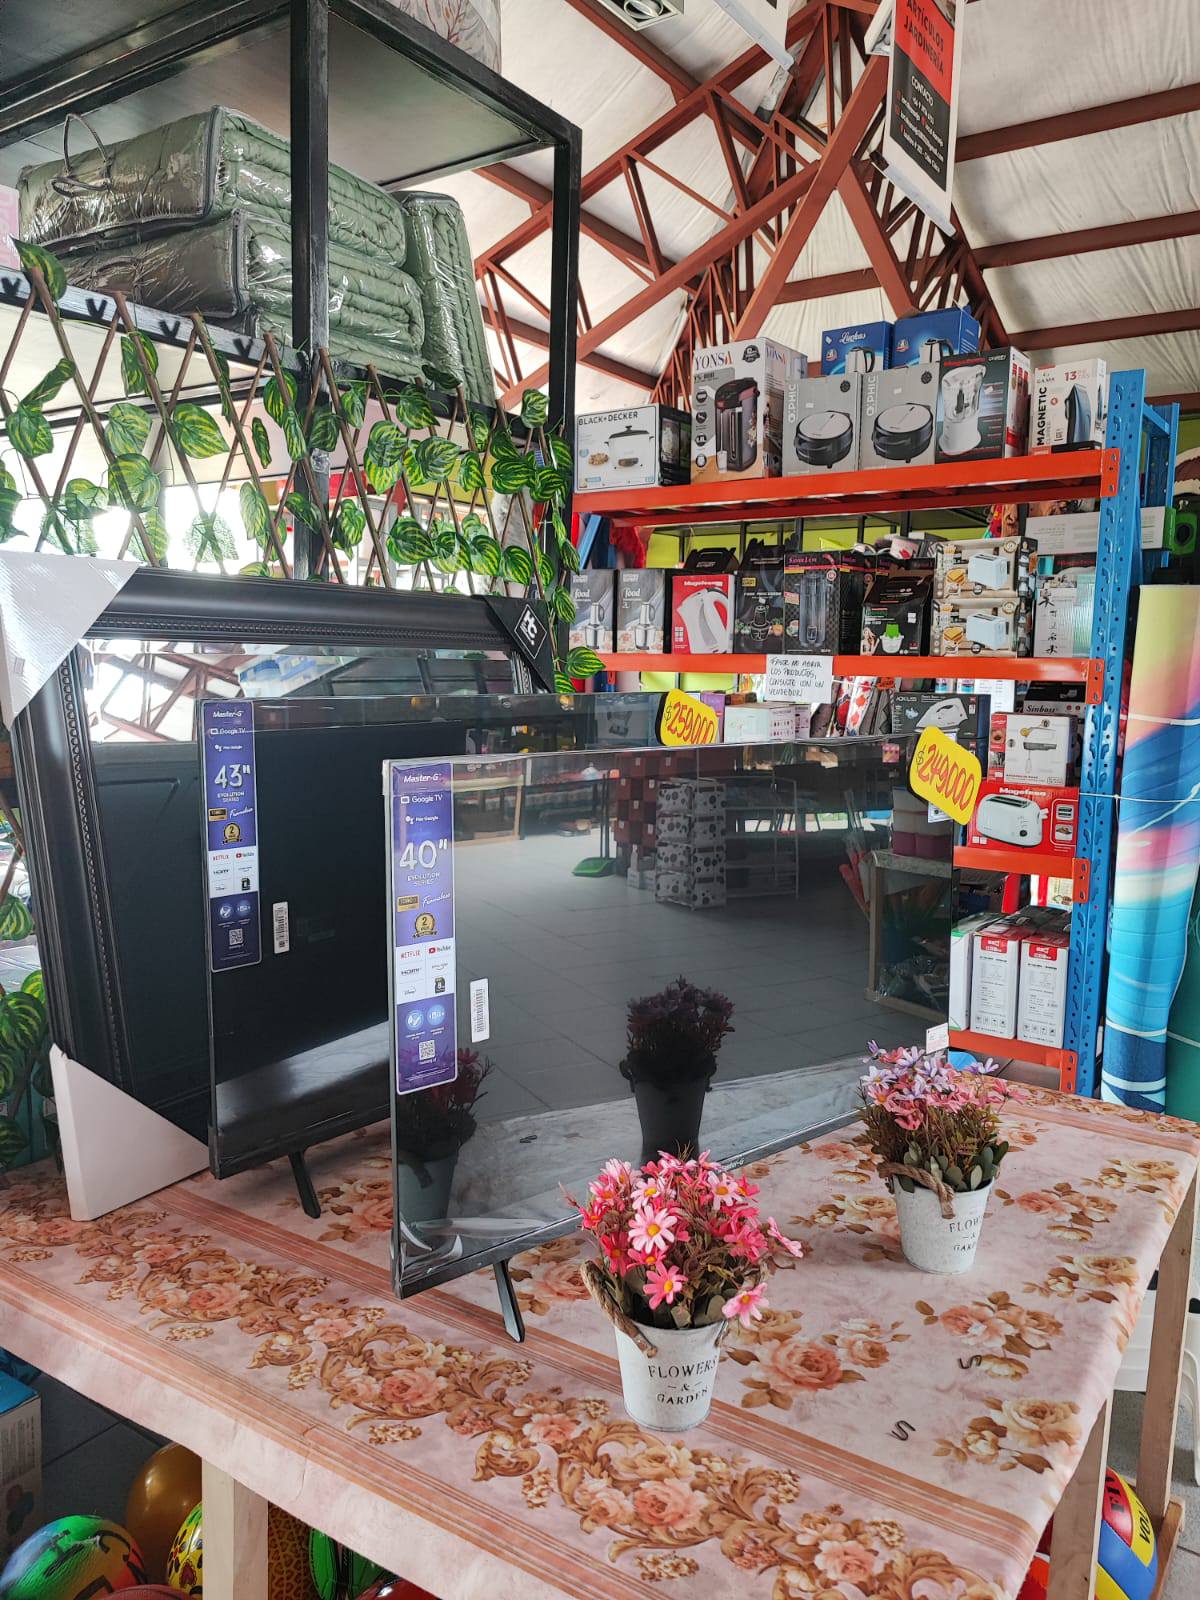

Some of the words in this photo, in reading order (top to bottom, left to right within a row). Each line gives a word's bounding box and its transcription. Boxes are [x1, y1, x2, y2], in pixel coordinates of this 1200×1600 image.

[695, 350, 733, 371] YONSA
[1064, 370, 1078, 382] 13
[1036, 386, 1048, 447] MAGNETIC
[214, 763, 251, 789] 43"
[403, 773, 440, 784] Master-G
[411, 795, 434, 804] Google
[434, 794, 443, 802] TV
[400, 838, 448, 871] 40"
[421, 916, 428, 926] 2
[400, 950, 421, 960] NETFLIX
[647, 1358, 717, 1378] FLOWERS
[656, 1387, 709, 1406] GARDEN
